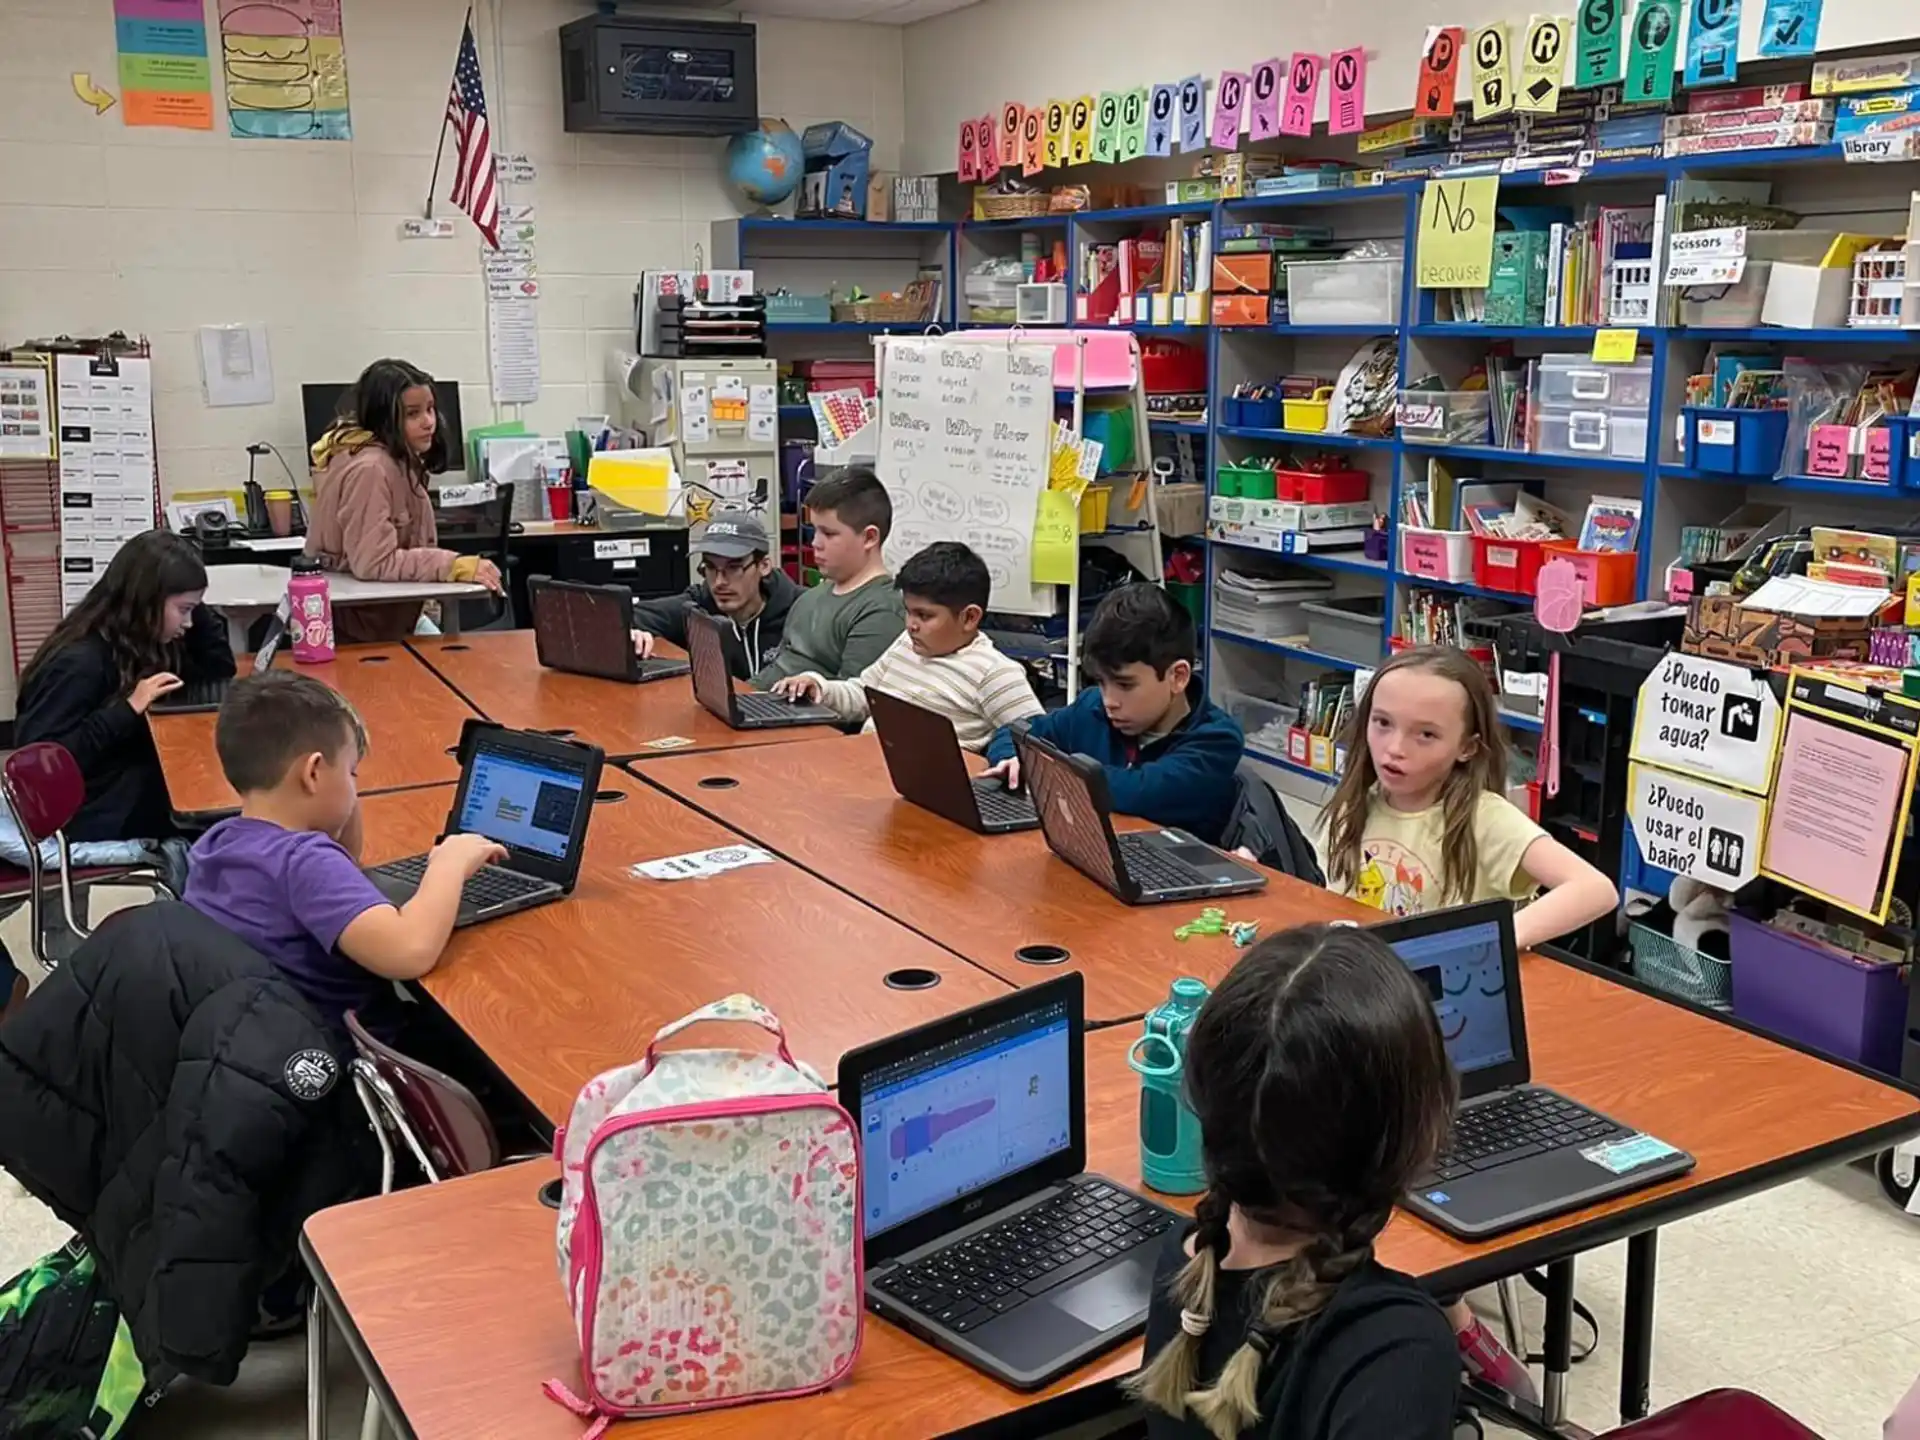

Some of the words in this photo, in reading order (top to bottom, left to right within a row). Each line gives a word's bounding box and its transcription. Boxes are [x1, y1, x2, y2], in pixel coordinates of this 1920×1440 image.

[1589, 0, 1610, 32] S
[1534, 26, 1558, 60] R
[1647, 11, 1668, 49] T
[1431, 38, 1451, 67] P
[1480, 32, 1498, 64] Q
[1259, 69, 1270, 96] L
[1296, 62, 1313, 90] M
[1337, 58, 1356, 87] N
[1184, 85, 1197, 112] J
[1225, 80, 1240, 108] K
[1006, 107, 1016, 132] C
[1050, 105, 1060, 130] E
[1074, 103, 1085, 128] F
[1102, 99, 1114, 125] G
[1125, 95, 1139, 123] H
[963, 125, 974, 149] A
[980, 123, 989, 147] B
[1026, 116, 1037, 140] D
[1845, 139, 1891, 155] library
[1432, 181, 1476, 233] No
[1693, 214, 1709, 227] The
[1713, 215, 1737, 227] New
[404, 222, 421, 233] flag
[1611, 221, 1654, 243] NANC
[1672, 237, 1722, 250] scissors
[487, 266, 513, 274] eraser
[1420, 264, 1482, 285] because
[1669, 266, 1698, 280] glue
[489, 284, 511, 292] book
[941, 350, 982, 370] What
[1007, 354, 1049, 377] When
[889, 411, 931, 432] Where
[945, 418, 983, 443] Why
[993, 423, 1030, 442] How
[442, 490, 467, 500] chair
[597, 544, 618, 554] desk
[1662, 661, 1720, 694] ¿Puedo
[1661, 692, 1716, 723] tomar
[1659, 724, 1710, 751] agua?
[1648, 783, 1704, 821] ¿Puedo
[1646, 816, 1684, 842] usar
[1688, 826, 1703, 850] el
[1647, 840, 1696, 875] baño?
